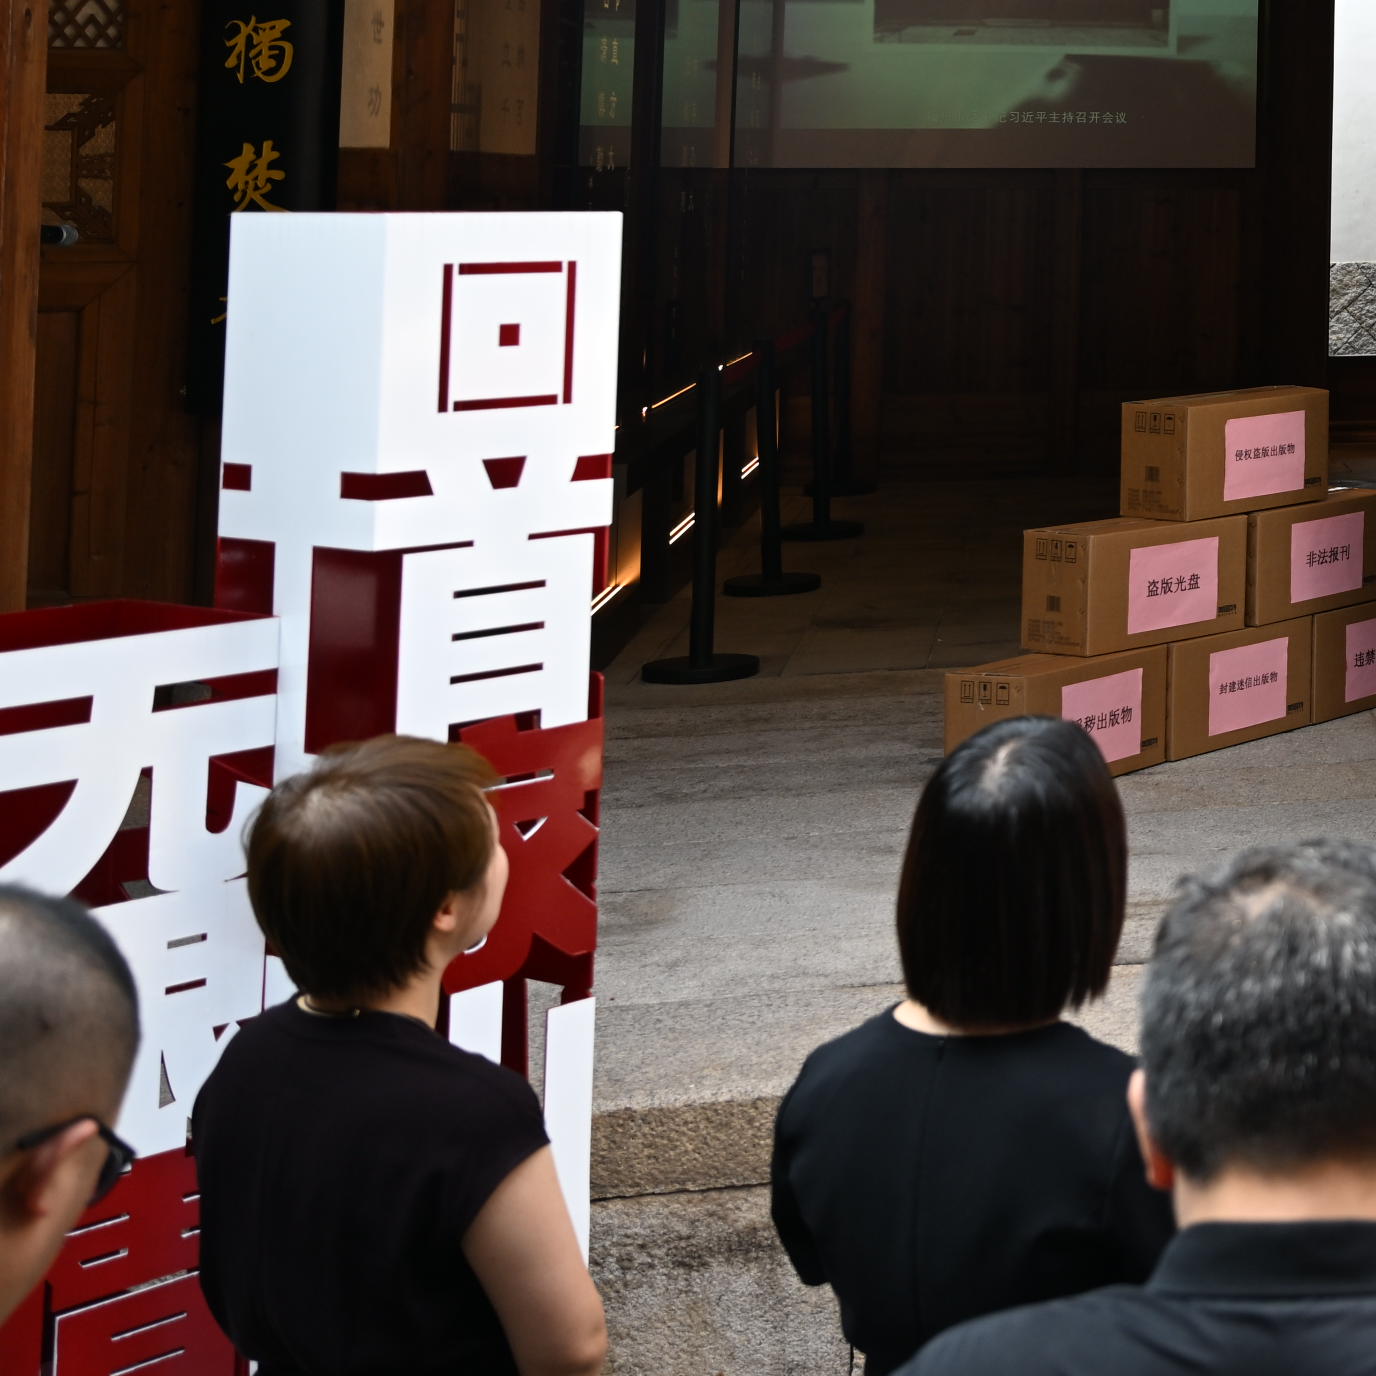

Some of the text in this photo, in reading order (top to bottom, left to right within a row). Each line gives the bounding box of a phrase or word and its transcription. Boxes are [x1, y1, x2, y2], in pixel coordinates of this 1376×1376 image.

[999, 111, 1128, 124] 习近平主持召开会议
[1234, 443, 1296, 463] 侵权盗版出版物
[1305, 543, 1351, 569] 非法报刊
[1146, 573, 1201, 599] 盗版光盘
[1218, 671, 1279, 696] 封建迷信出版物
